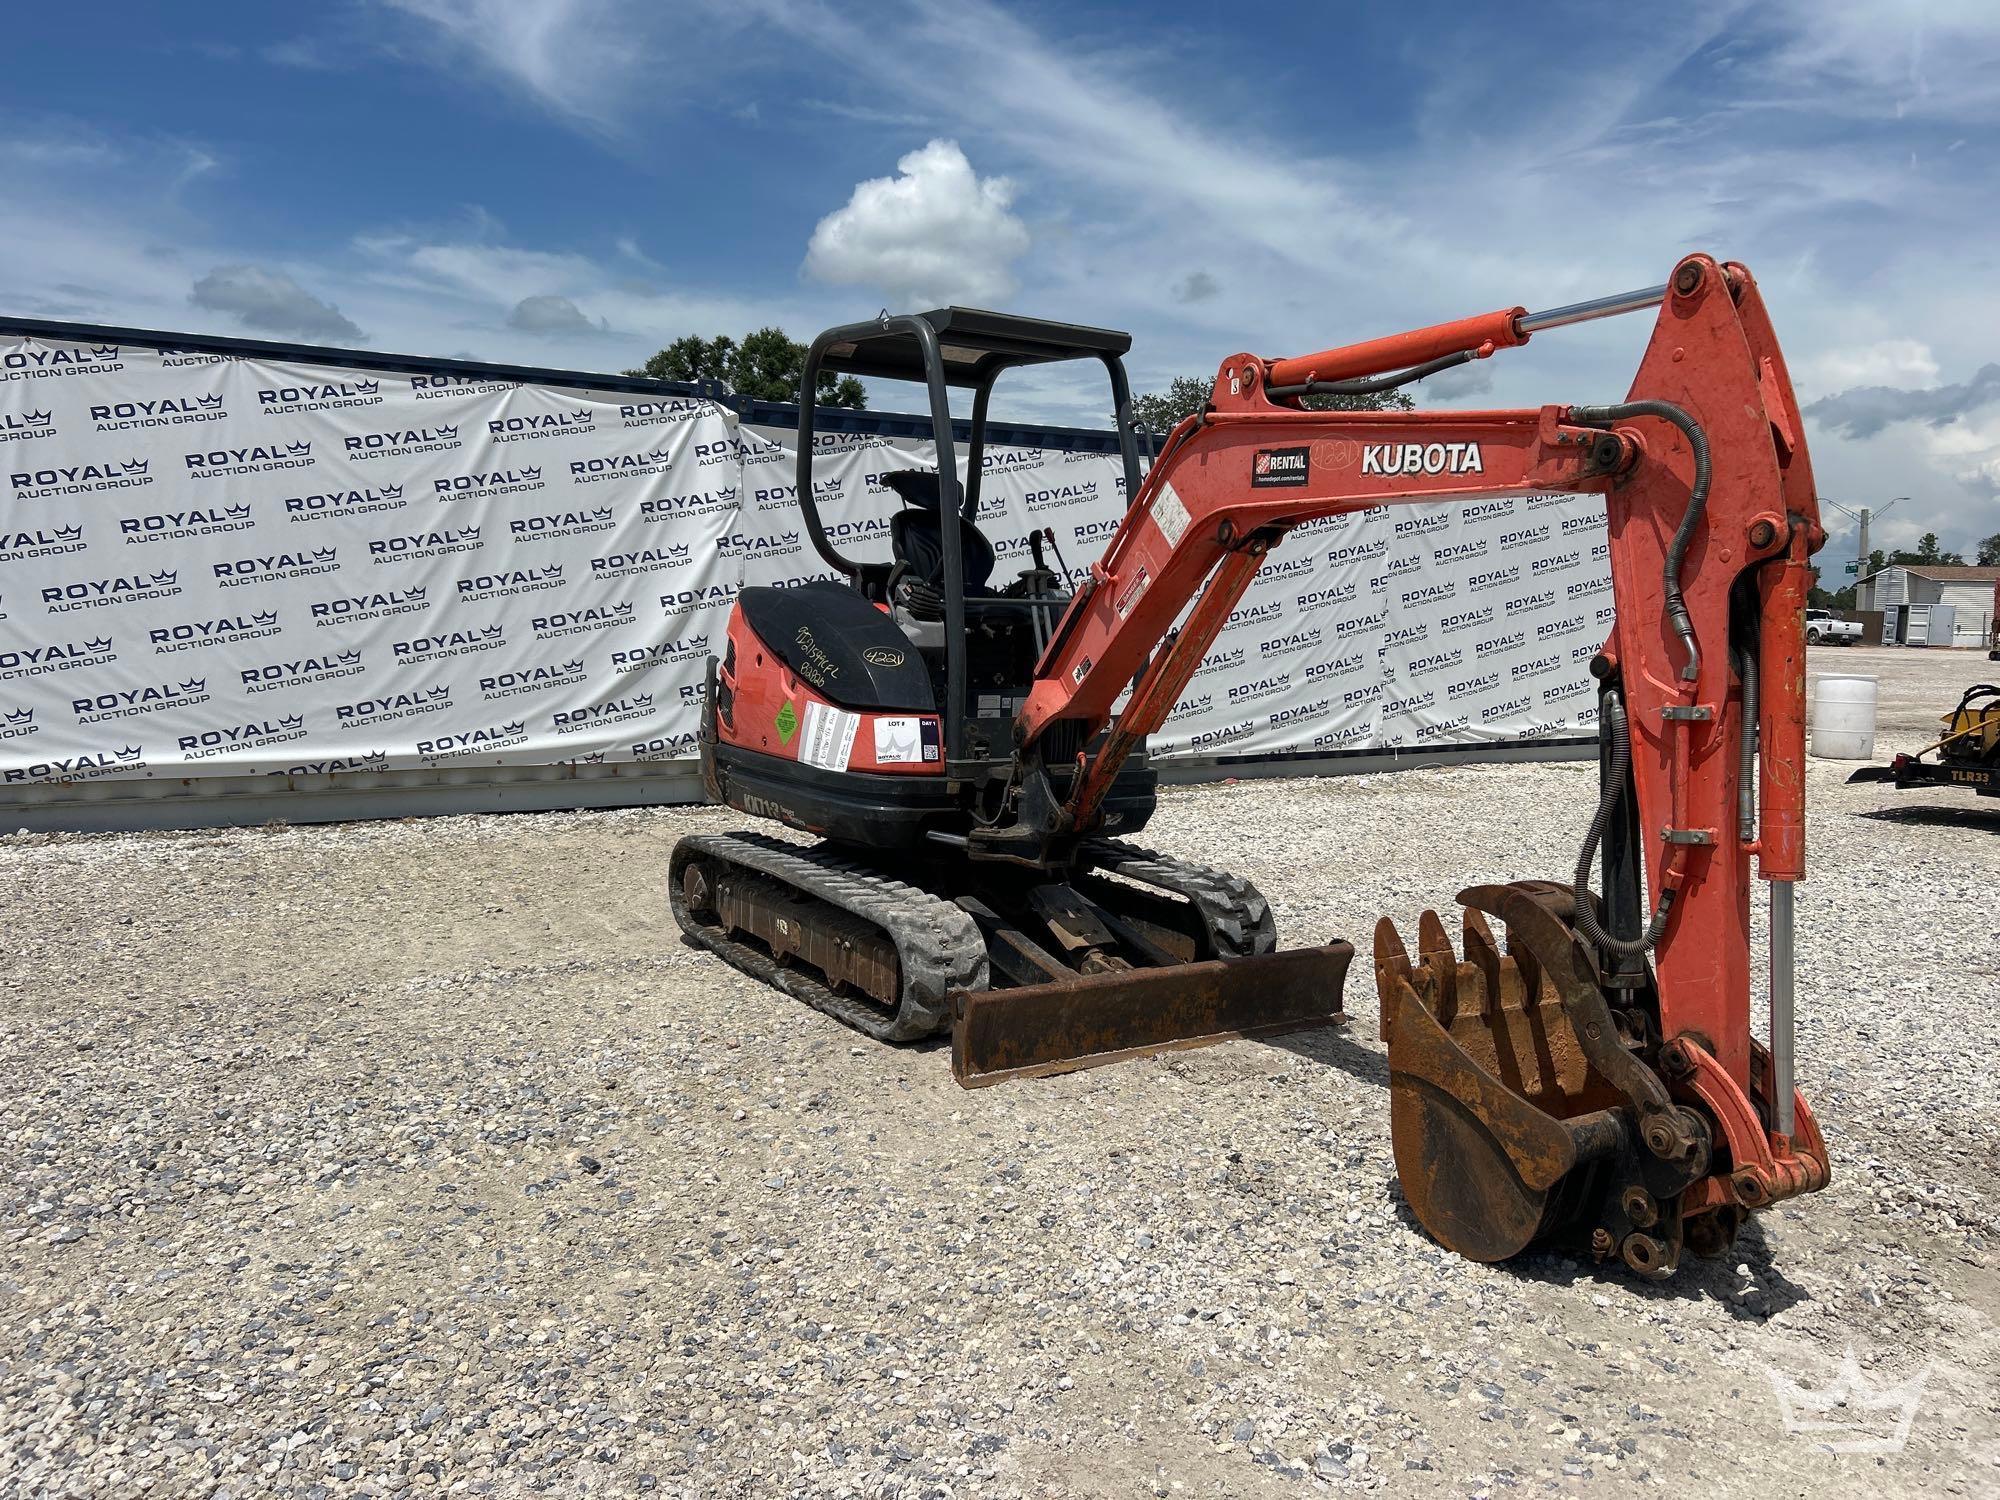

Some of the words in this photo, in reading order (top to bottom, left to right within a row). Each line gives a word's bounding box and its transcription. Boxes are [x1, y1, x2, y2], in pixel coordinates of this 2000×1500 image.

[258, 384, 356, 404] ROYAL
[90, 398, 198, 420] ROYAL
[264, 402, 329, 415] AUCTION
[332, 397, 383, 408] GROUP
[96, 418, 168, 431] AUCTION
[172, 412, 228, 424] GROUP
[488, 414, 572, 433] ROYAL
[344, 429, 436, 450] ROYAL
[493, 430, 549, 443] AUCTION
[552, 425, 596, 436] GROUP
[185, 446, 287, 468] ROYAL
[350, 447, 411, 460] AUCTION
[414, 441, 462, 453] GROUP
[1361, 441, 1483, 474] KUBOTA
[191, 464, 259, 479] AUCTION
[263, 458, 316, 471] GROUP
[570, 454, 650, 474] ROYAL
[1270, 455, 1305, 470] RENTAL
[10, 464, 122, 488] ROYAL
[434, 471, 521, 492] ROYAL
[574, 471, 628, 484] AUCTION
[631, 465, 672, 476] GROUP
[17, 484, 92, 500] AUCTION
[95, 477, 154, 490] GROUP
[439, 488, 497, 502] AUCTION
[500, 482, 545, 494] GROUP
[1025, 486, 1082, 504] ROYAL
[285, 489, 380, 512] ROYAL
[1028, 500, 1066, 512] AUCTION
[1068, 495, 1098, 505] GROUP
[1463, 503, 1503, 518] ROYAL
[120, 509, 226, 534] ROYAL
[291, 508, 354, 522] AUCTION
[358, 501, 407, 514] GROUP
[1464, 514, 1491, 524] AUCTION
[1493, 510, 1514, 518] GROUP
[126, 528, 197, 544] AUCTION
[200, 521, 255, 535] GROUP
[510, 512, 593, 533] ROYAL
[514, 529, 570, 543] AUCTION
[573, 522, 616, 534] GROUP
[1395, 517, 1437, 533] ROYAL
[1396, 529, 1425, 540] AUCTION
[1427, 524, 1449, 533] GROUP
[369, 531, 459, 555] ROYAL
[1500, 528, 1539, 544] ROYAL
[1501, 540, 1528, 551] AUCTION
[1529, 535, 1549, 544] GROUP
[374, 549, 434, 564] AUCTION
[437, 542, 484, 555] GROUP
[591, 549, 669, 571] ROYAL
[1328, 544, 1373, 561] ROYAL
[1330, 557, 1360, 568] AUCTION
[1362, 551, 1386, 561] GROUP
[1434, 543, 1476, 560] ROYAL
[1435, 555, 1464, 566] AUCTION
[1465, 550, 1487, 559] GROUP
[214, 553, 313, 578] ROYAL
[595, 566, 648, 580] AUCTION
[650, 558, 692, 571] GROUP
[1532, 555, 1570, 570] ROYAL
[1533, 566, 1559, 577] AUCTION
[1560, 561, 1580, 570] GROUP
[219, 572, 286, 588] AUCTION
[289, 564, 341, 577] GROUP
[457, 570, 542, 593] ROYAL
[1469, 570, 1508, 586] ROYAL
[1470, 582, 1497, 592] AUCTION
[1499, 576, 1519, 585] GROUP
[42, 576, 151, 603] ROYAL
[461, 587, 519, 602] AUCTION
[522, 580, 566, 592] GROUP
[1298, 588, 1344, 606] ROYAL
[1402, 586, 1444, 603] ROYAL
[48, 596, 122, 614] AUCTION
[125, 587, 182, 602] GROUP
[311, 592, 404, 617] ROYAL
[1299, 600, 1331, 613] AUCTION
[1332, 594, 1356, 604] GROUP
[1403, 598, 1432, 609] AUCTION
[1433, 592, 1455, 602] GROUP
[1506, 594, 1544, 610] ROYAL
[1507, 606, 1533, 617] AUCTION
[1534, 600, 1555, 610] GROUP
[316, 610, 379, 627] AUCTION
[382, 602, 430, 616] GROUP
[532, 607, 613, 631] ROYAL
[1441, 610, 1482, 628] ROYAL
[150, 617, 253, 644] ROYAL
[536, 624, 591, 640] AUCTION
[594, 616, 636, 630] GROUP
[1442, 623, 1470, 634] AUCTION
[1472, 617, 1494, 626] GROUP
[1538, 619, 1575, 635] ROYAL
[1539, 630, 1564, 642] AUCTION
[1566, 625, 1585, 634] GROUP
[156, 636, 225, 654] AUCTION
[228, 627, 282, 642] GROUP
[393, 631, 481, 656] ROYAL
[1261, 633, 1308, 652] ROYAL
[1262, 646, 1295, 659] AUCTION
[1296, 640, 1322, 650] GROUP
[398, 649, 457, 666] AUCTION
[460, 640, 506, 654] GROUP
[866, 651, 901, 665] 4221
[241, 657, 338, 684] ROYAL
[1306, 658, 1351, 677] ROYAL
[1308, 671, 1338, 684] AUCTION
[1340, 664, 1364, 675] GROUP
[247, 676, 312, 694] AUCTION
[315, 666, 366, 681] GROUP
[480, 666, 564, 691] ROYAL
[484, 683, 541, 700] AUCTION
[543, 674, 587, 688] GROUP
[1228, 678, 1277, 698] ROYAL
[1448, 676, 1488, 695] ROYAL
[72, 685, 180, 714] ROYAL
[1230, 692, 1263, 705] AUCTION
[1265, 685, 1291, 696] GROUP
[1449, 689, 1477, 701] AUCTION
[1478, 682, 1500, 692] GROUP
[79, 705, 151, 724] AUCTION
[154, 695, 210, 711] GROUP
[336, 692, 428, 720] ROYAL
[341, 711, 403, 729] AUCTION
[406, 701, 453, 716] GROUP
[553, 700, 633, 726] ROYAL
[1270, 704, 1316, 724] ROYAL
[558, 717, 612, 735] AUCTION
[614, 708, 656, 722] GROUP
[1271, 717, 1303, 731] AUCTION
[1304, 710, 1329, 721] GROUP
[178, 722, 279, 751] ROYAL
[184, 741, 252, 761] AUCTION
[255, 730, 308, 746] GROUP
[417, 728, 504, 755] ROYAL
[422, 746, 480, 764] AUCTION
[483, 736, 529, 750] GROUP
[1951, 770, 1989, 782] TLR33
